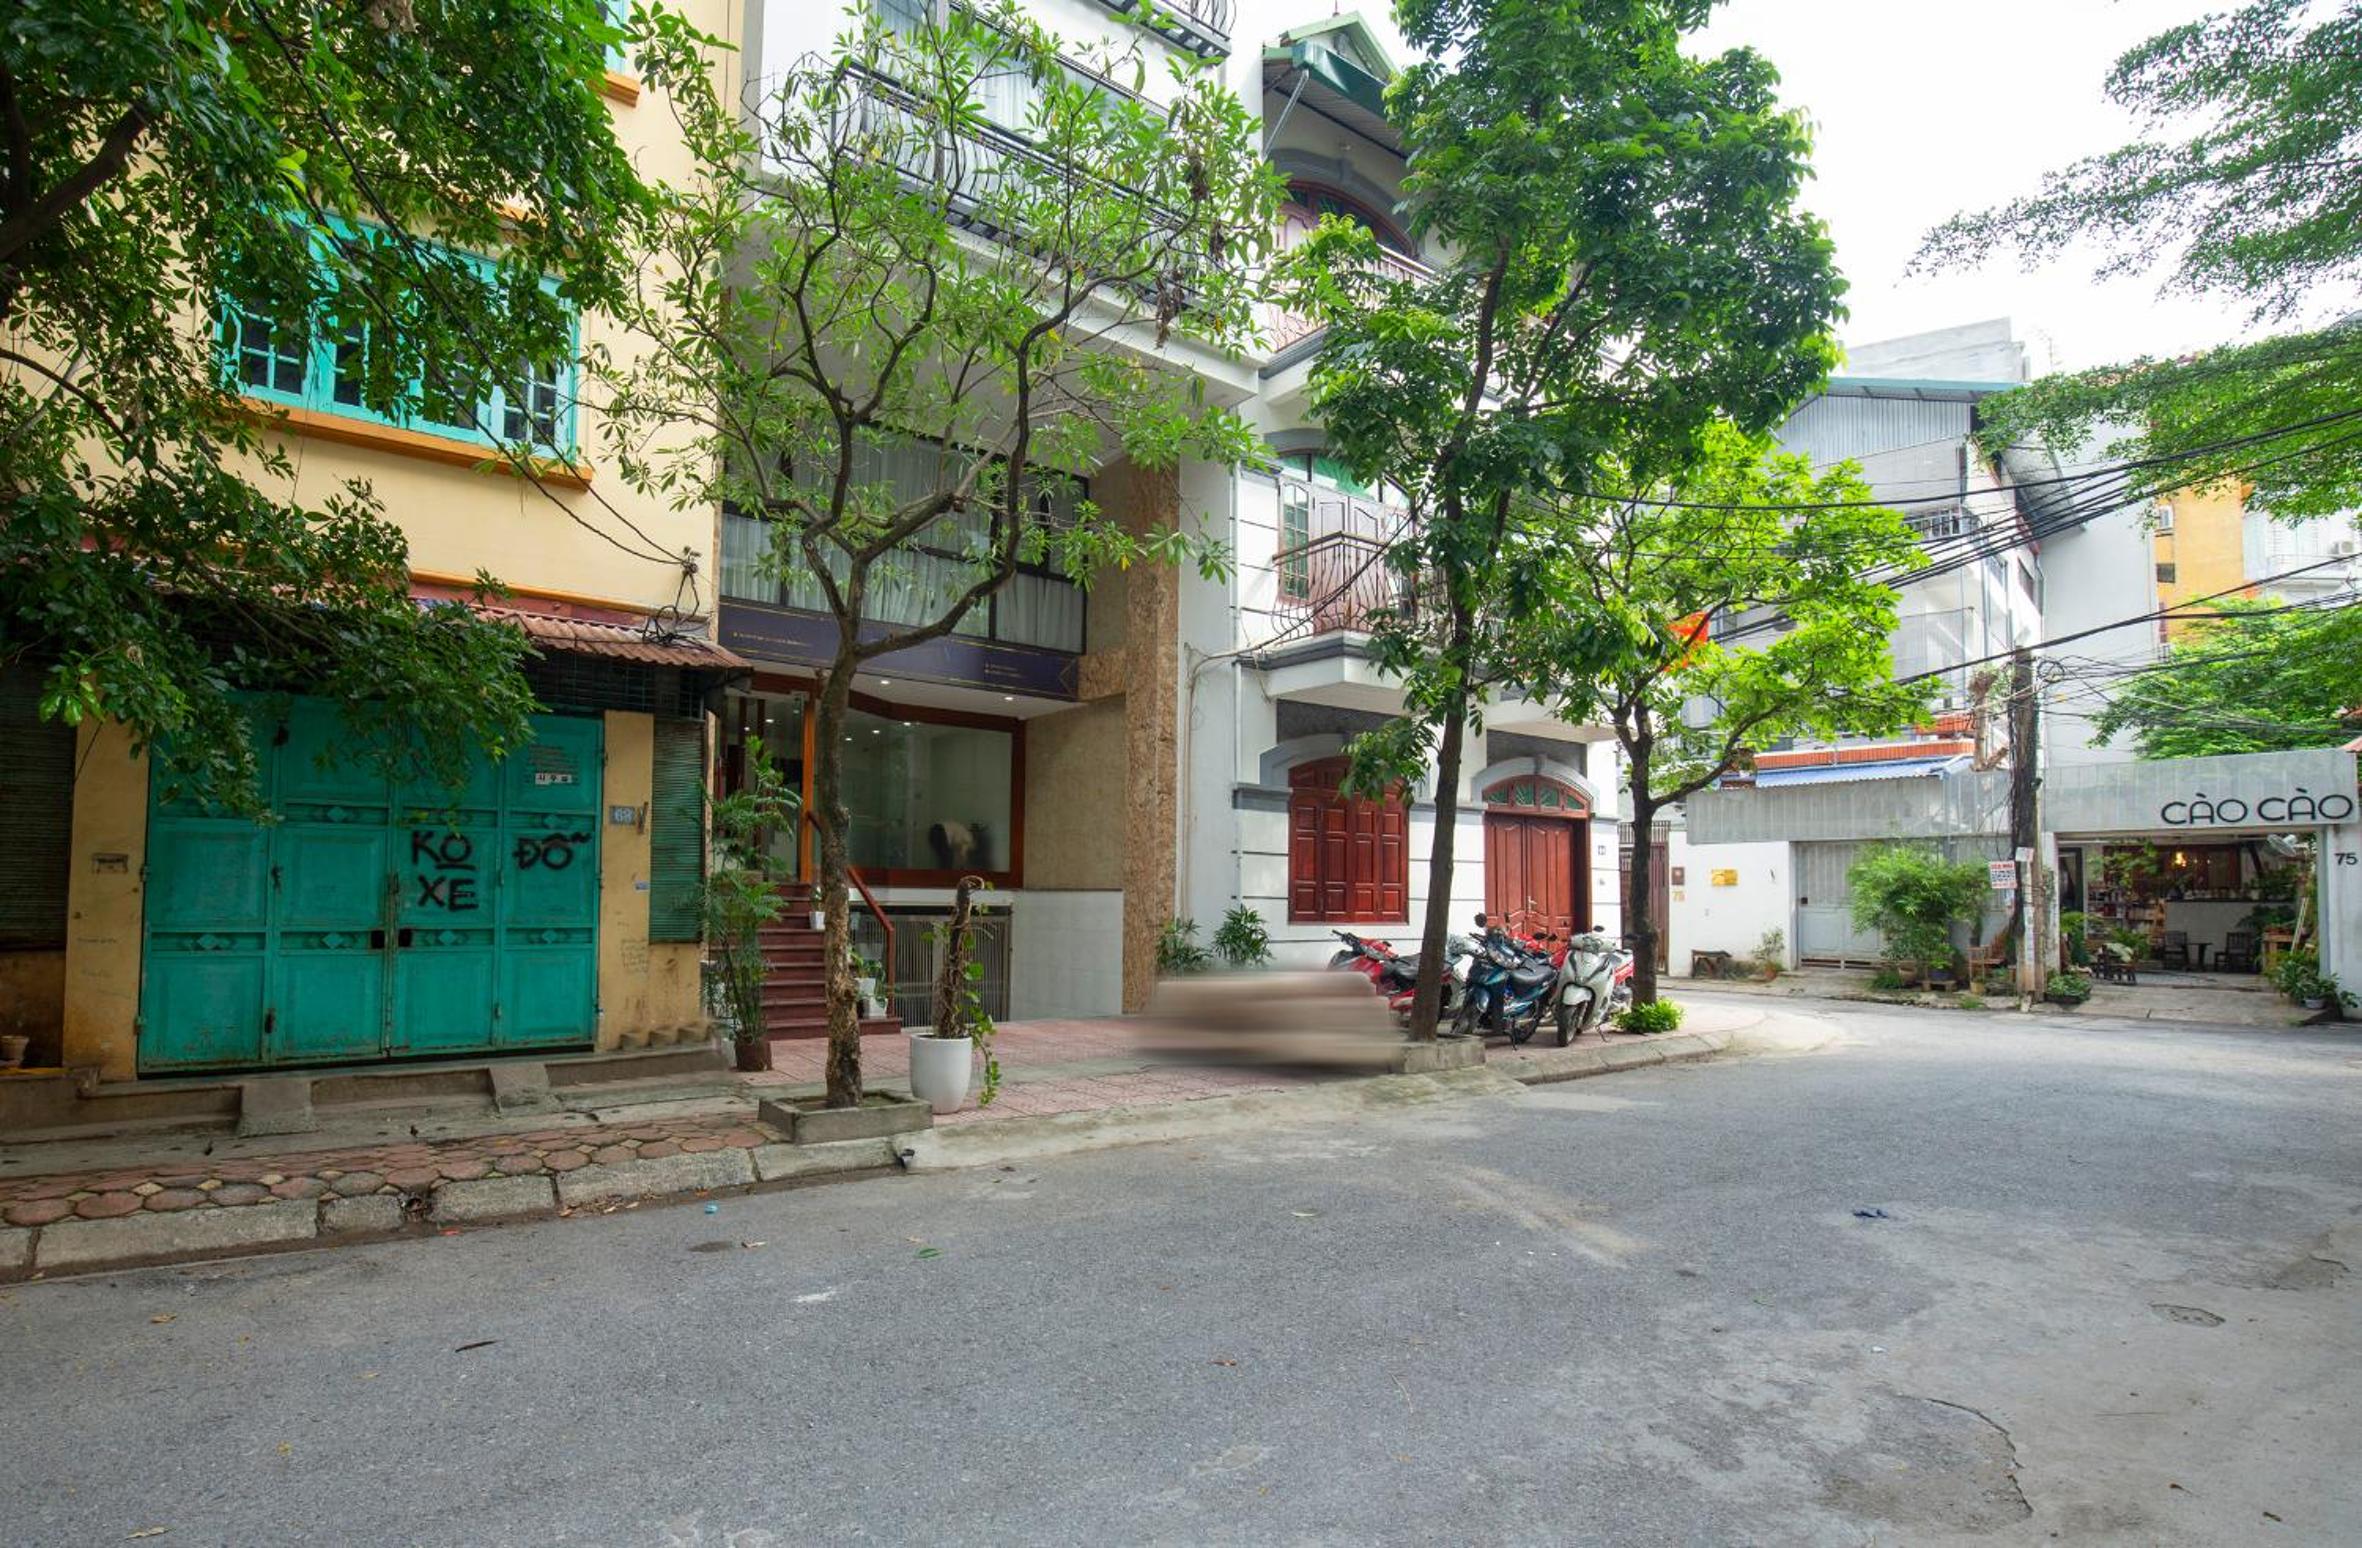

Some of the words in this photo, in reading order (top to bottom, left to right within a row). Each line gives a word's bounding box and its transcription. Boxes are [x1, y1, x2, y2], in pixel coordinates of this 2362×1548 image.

[2161, 793, 2248, 825] CÀO
[2257, 787, 2353, 821] CÀO
[2335, 852, 2358, 866] 75
[417, 874, 480, 912] XE
